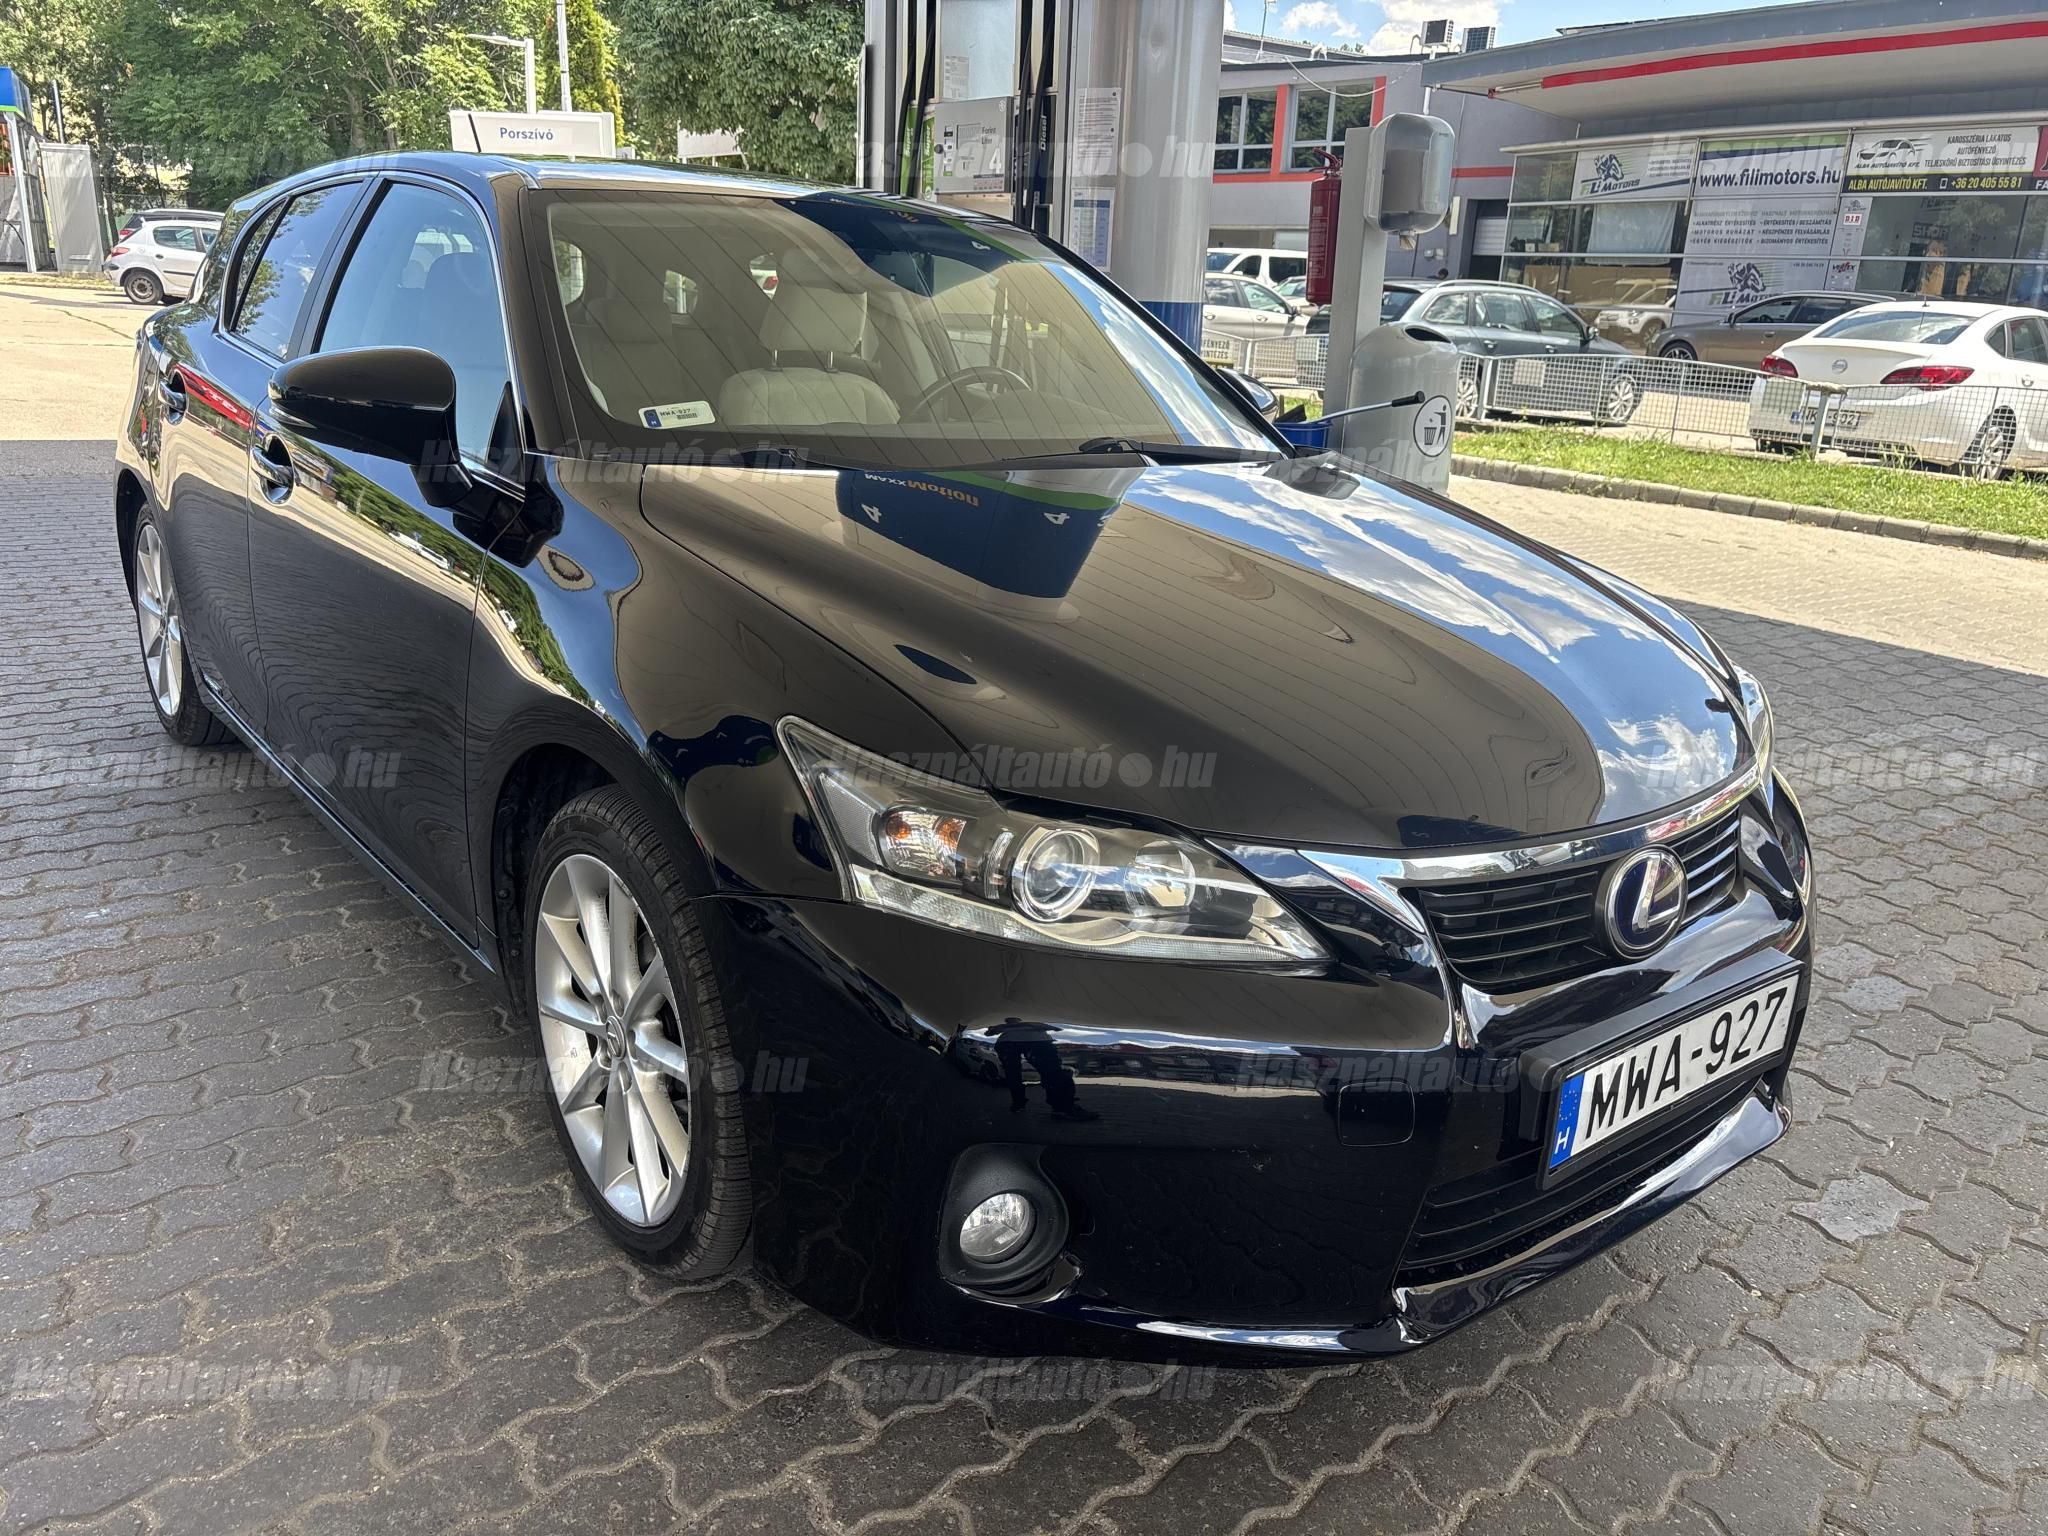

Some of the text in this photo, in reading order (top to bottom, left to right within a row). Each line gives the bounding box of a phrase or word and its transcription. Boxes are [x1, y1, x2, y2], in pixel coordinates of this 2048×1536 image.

[500, 127, 554, 141] Porszívó
[1039, 115, 1048, 151] Diesel
[989, 148, 1001, 174] 4
[1699, 165, 1842, 188] www.filimotors.hu
[1848, 177, 1928, 190] ALBA AUTÓJAVÍTÓ KFT.
[1951, 177, 1967, 189] +36
[1968, 177, 1980, 188] 20
[1980, 177, 1997, 188] 405
[2010, 176, 2023, 188] 81
[1585, 986, 1789, 1140] MWA-927
[1554, 1126, 1571, 1156] H
